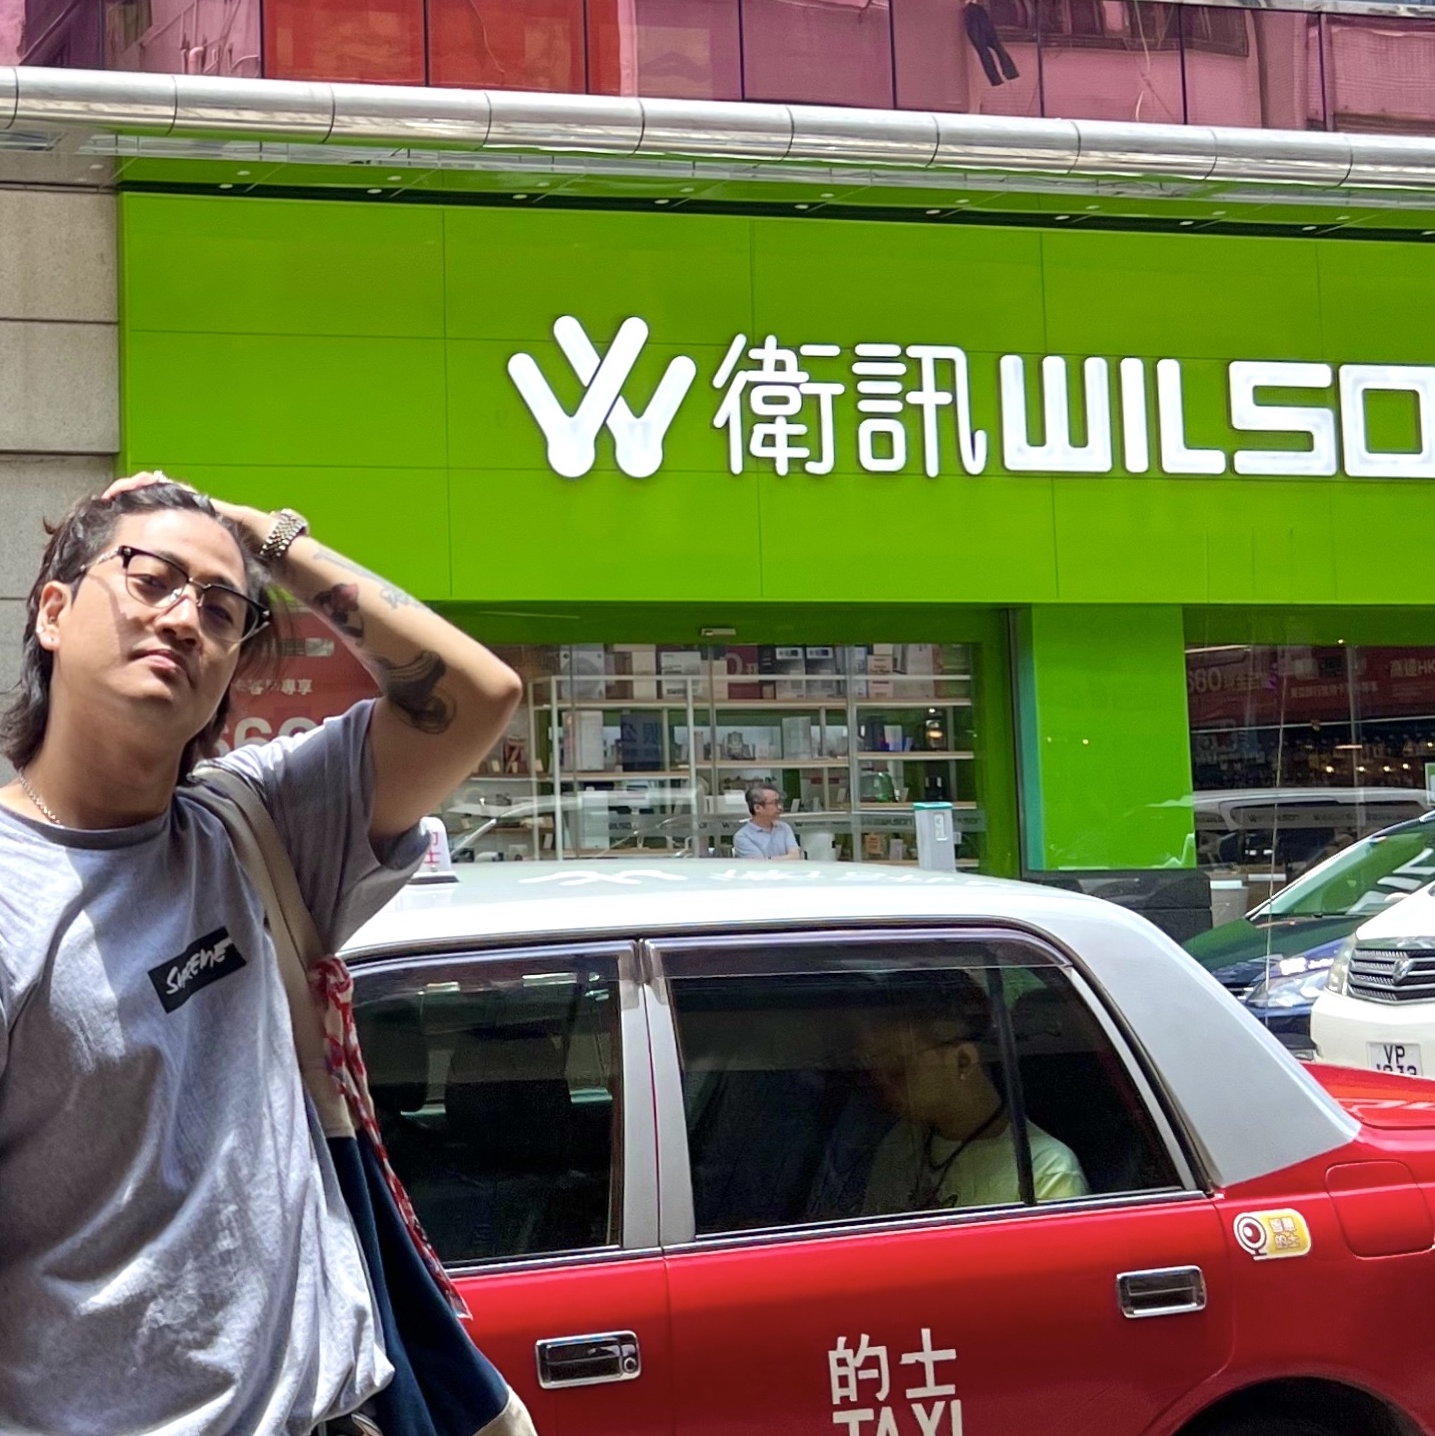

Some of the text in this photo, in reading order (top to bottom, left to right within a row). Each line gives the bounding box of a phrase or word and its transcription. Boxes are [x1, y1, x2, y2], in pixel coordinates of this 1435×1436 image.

[712, 333, 987, 478] 衛訊
[1383, 1044, 1406, 1065] VP
[828, 1328, 957, 1405] 的士
